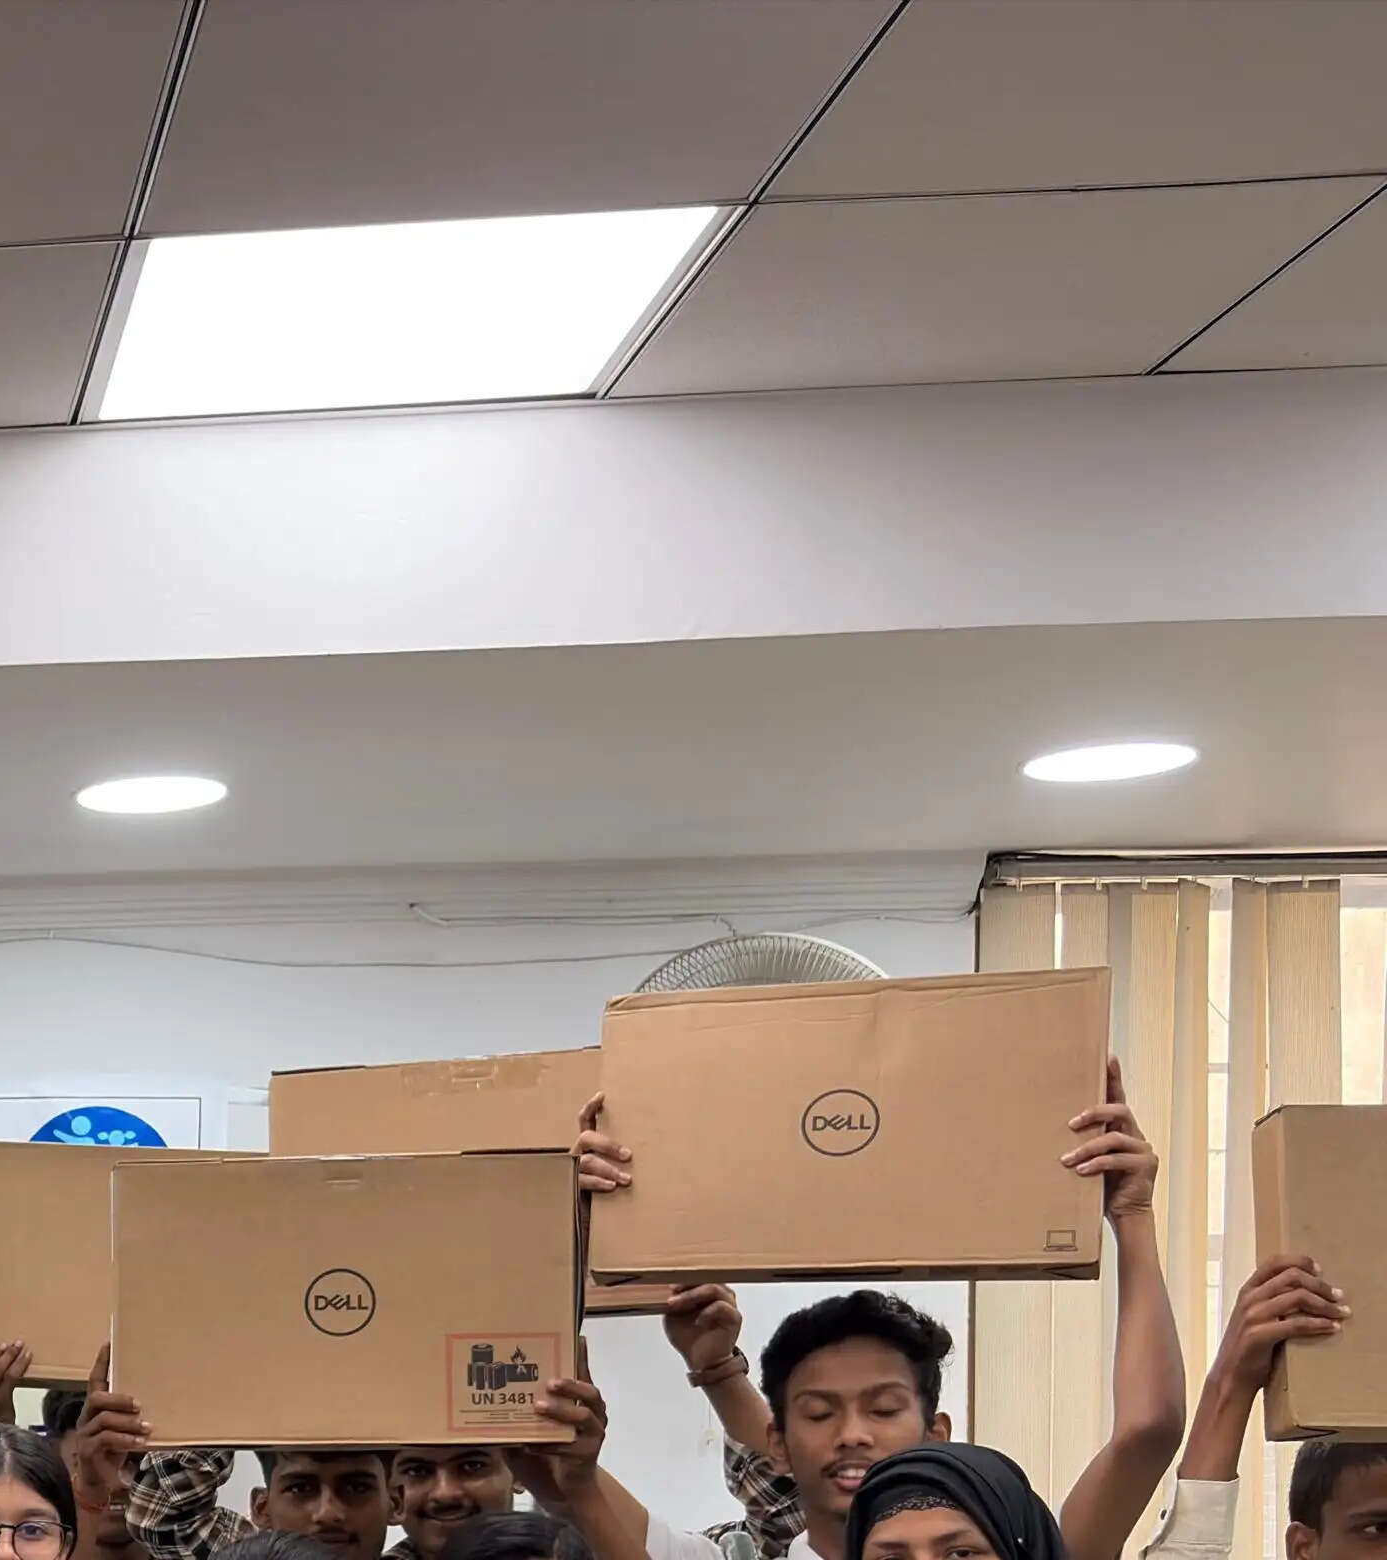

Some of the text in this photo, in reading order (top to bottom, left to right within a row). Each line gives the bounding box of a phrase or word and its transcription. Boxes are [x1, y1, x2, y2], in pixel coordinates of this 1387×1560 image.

[812, 1113, 871, 1134] DELL
[314, 1294, 369, 1312] DELL
[471, 1392, 535, 1405] UN 3481
